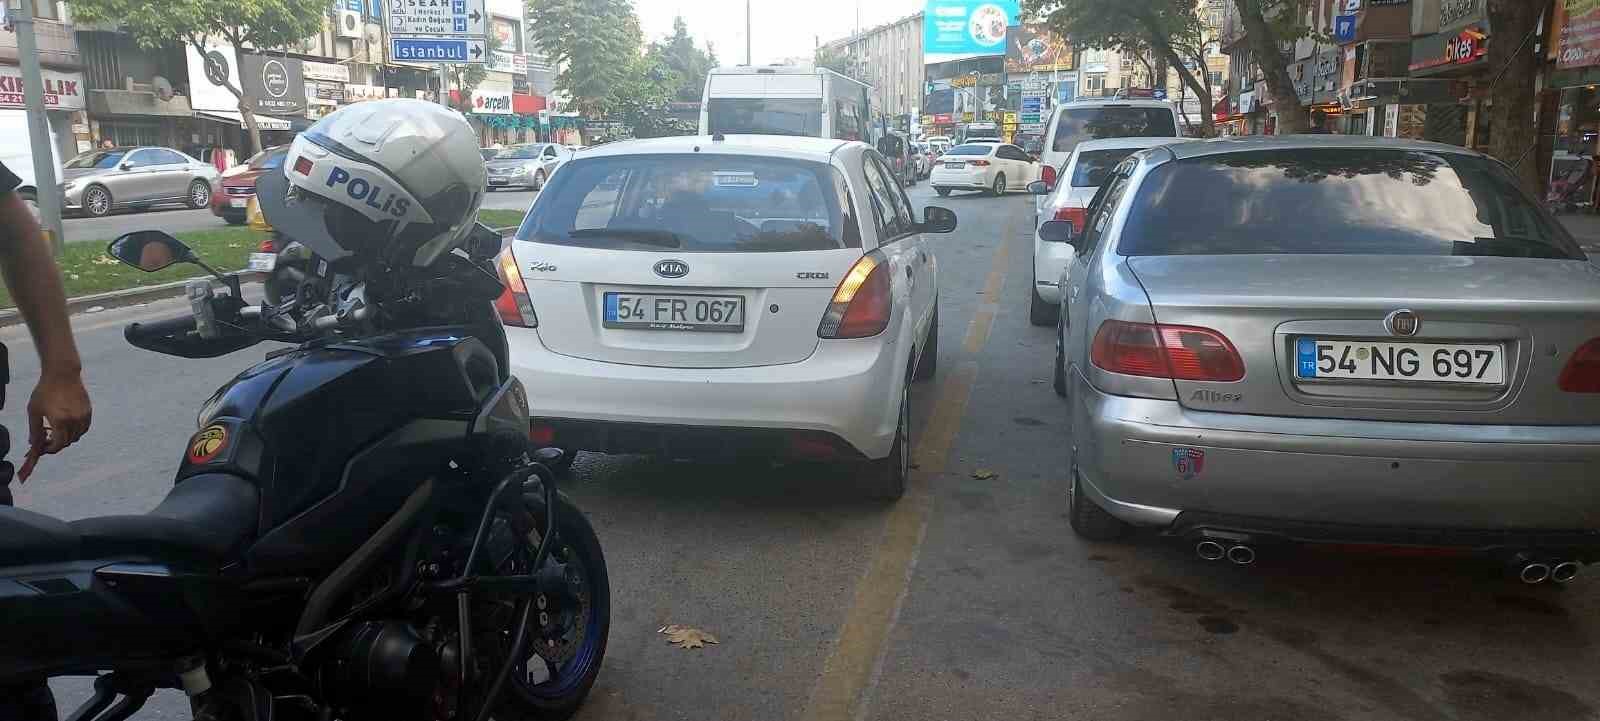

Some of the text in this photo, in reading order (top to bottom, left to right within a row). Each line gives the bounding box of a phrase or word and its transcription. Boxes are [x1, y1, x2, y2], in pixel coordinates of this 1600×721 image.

[1446, 36, 1473, 62] bikes
[484, 96, 510, 113] arçelik
[660, 263, 683, 273] KIA
[618, 298, 645, 320] 54
[655, 299, 688, 322] FR
[695, 301, 738, 323] 067
[1317, 345, 1357, 374] 54
[1371, 346, 1420, 377] NG
[1432, 348, 1495, 379] 697
